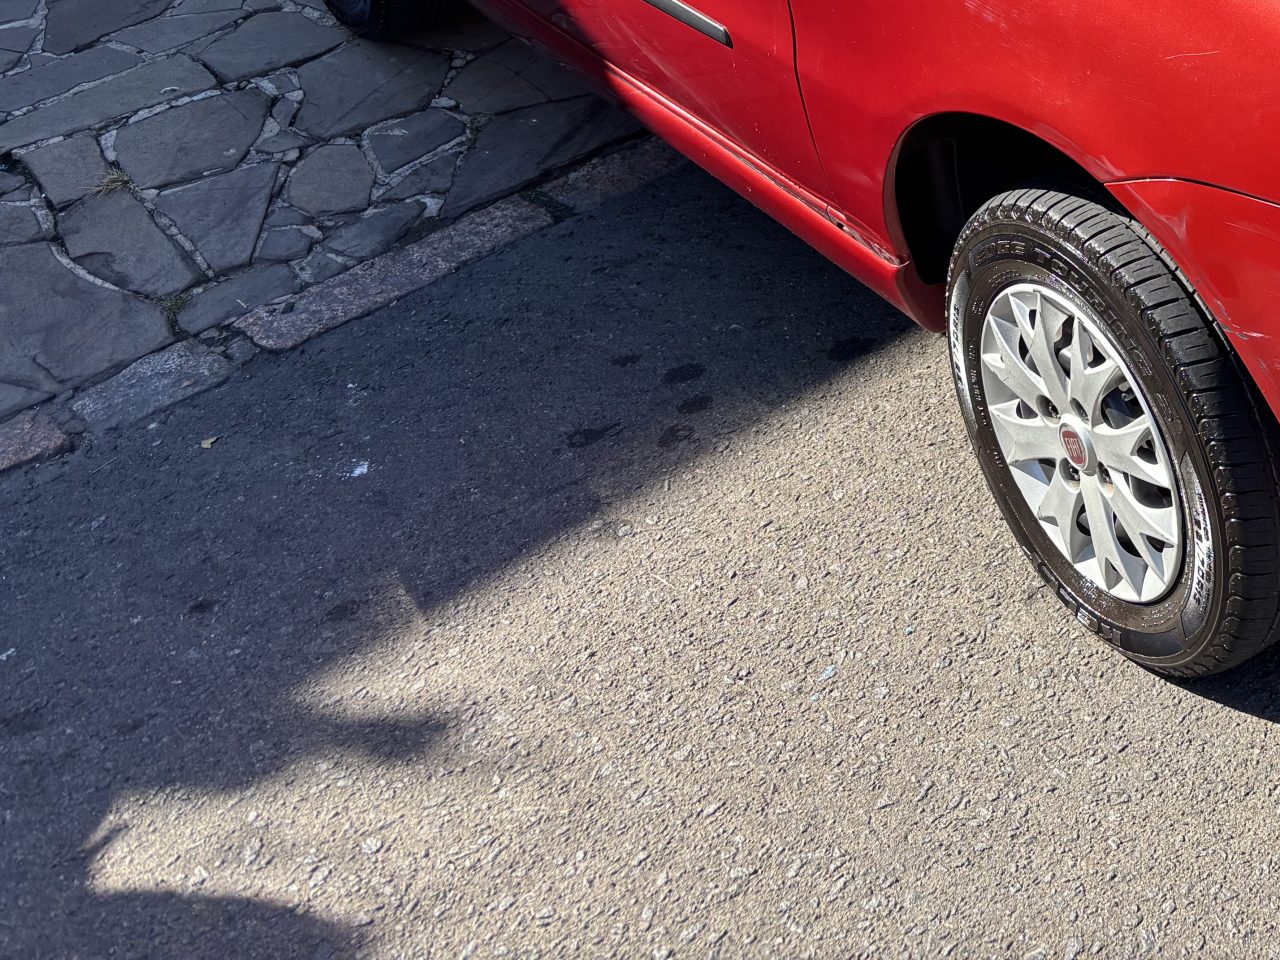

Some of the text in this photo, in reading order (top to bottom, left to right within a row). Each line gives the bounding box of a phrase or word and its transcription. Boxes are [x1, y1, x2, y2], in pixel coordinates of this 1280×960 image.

[976, 239, 1153, 377] EDGE TOURING
[1063, 437, 1083, 457] FIAT
